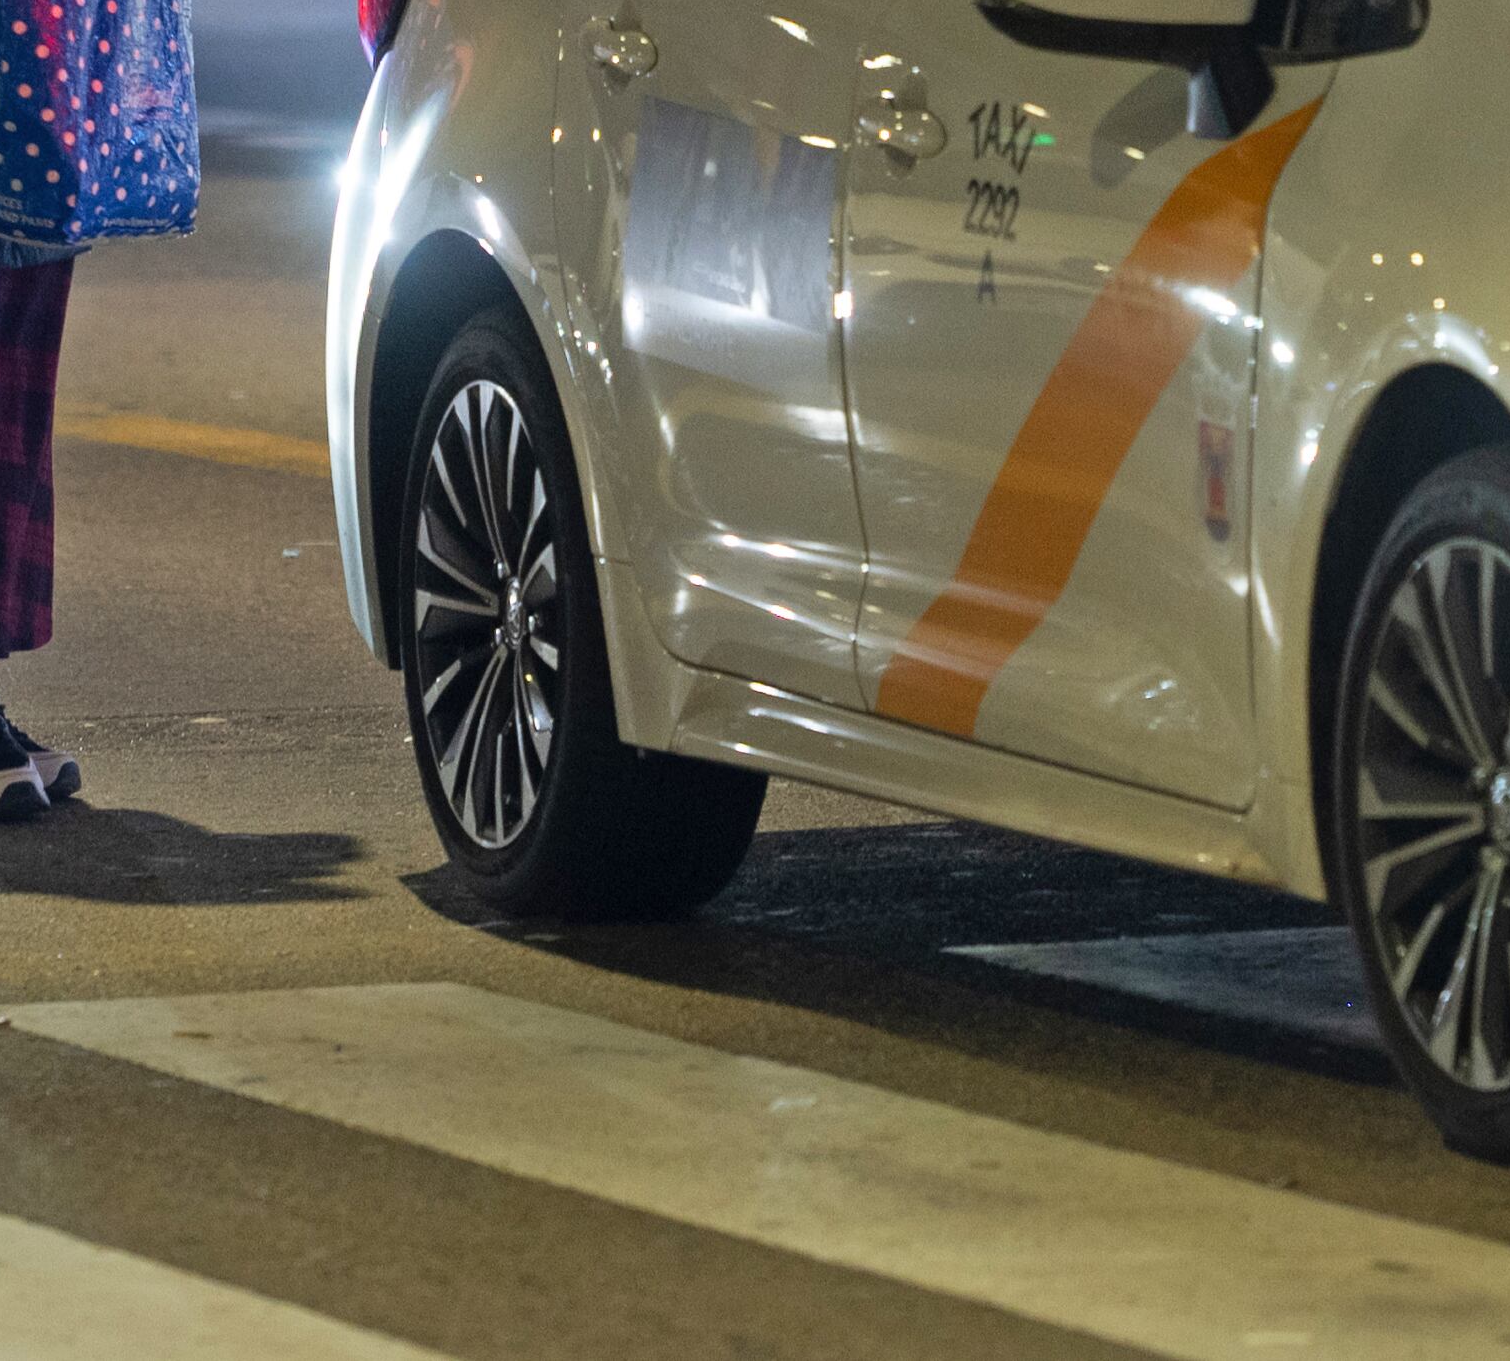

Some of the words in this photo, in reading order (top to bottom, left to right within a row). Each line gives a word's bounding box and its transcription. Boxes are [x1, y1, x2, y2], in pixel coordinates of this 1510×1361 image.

[968, 101, 1037, 174] TAXI
[964, 179, 1020, 240] 2292
[977, 249, 997, 305] A
